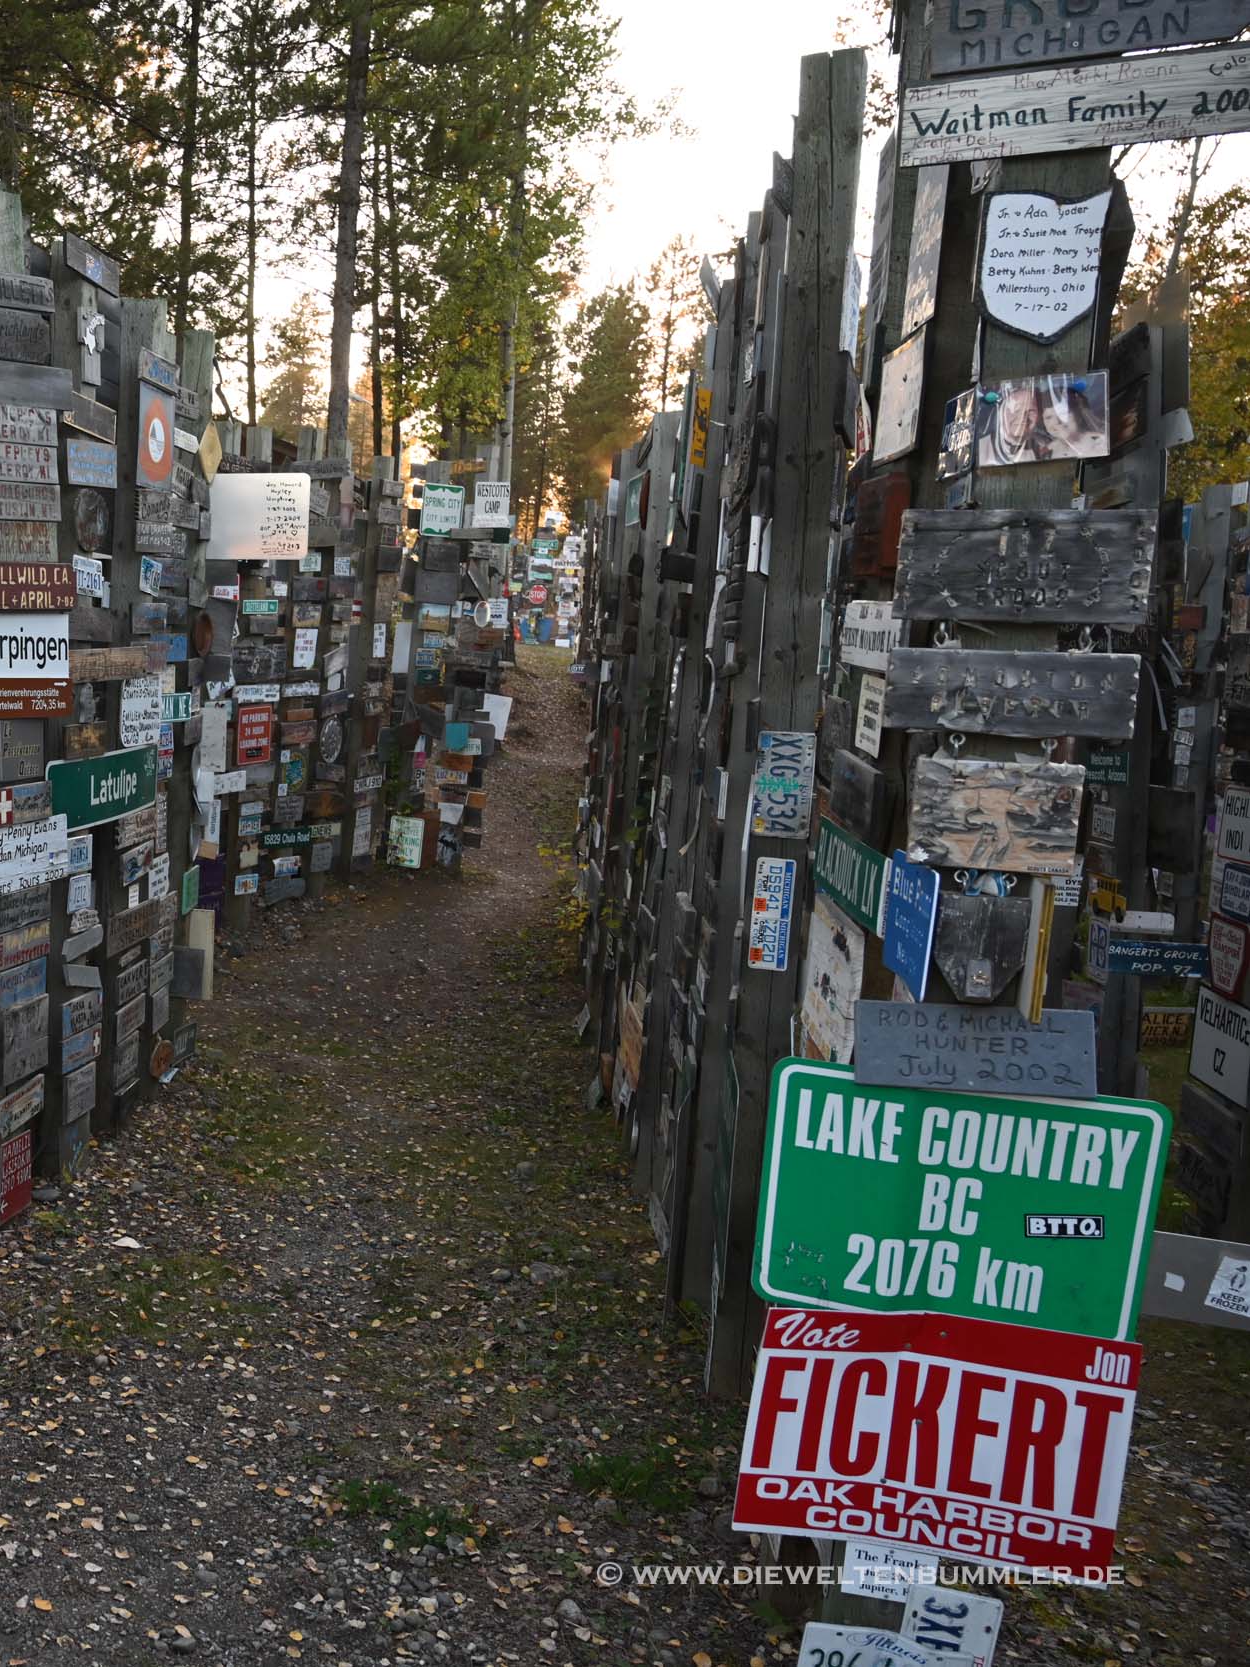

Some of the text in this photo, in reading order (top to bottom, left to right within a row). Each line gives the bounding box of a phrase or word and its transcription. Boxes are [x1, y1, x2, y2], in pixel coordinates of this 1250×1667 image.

[960, 6, 1190, 66] MICHIGAN
[1067, 90, 1167, 124] Family
[1053, 264, 1077, 276] Betty
[1062, 283, 1085, 292] Ohio
[1014, 302, 1068, 312] 7-17-02
[477, 484, 510, 500] WESTCOTTS
[425, 496, 461, 511] SPRING CITY
[484, 501, 501, 514] CAMP
[20, 591, 55, 609] APRIL
[530, 590, 547, 599] STOP
[90, 769, 137, 806] Latulipe
[34, 822, 58, 835] Evans
[297, 832, 311, 842] Road
[14, 841, 48, 861] Michigan
[815, 827, 878, 917] BLACKDUCK LK
[783, 872, 793, 916] MICHIGAN
[1131, 962, 1166, 973] POP.
[878, 1008, 928, 1026] ROD
[915, 1036, 1030, 1055] HUNTER
[898, 1053, 1083, 1088] July 2002
[1213, 1047, 1227, 1077] CZ
[794, 1087, 1141, 1191] LAKE COUNTRY
[918, 1173, 983, 1237] BC
[843, 1233, 1044, 1315] 2076 km
[1211, 1296, 1249, 1313] FROZEN
[1221, 1292, 1245, 1303] KEEP
[772, 1311, 1131, 1386] Vote Jon
[750, 1355, 1125, 1520] FICKERT
[755, 1477, 1093, 1551] OAK HARBOR
[804, 1505, 1026, 1564] COUNCIL
[854, 1548, 879, 1563] The
